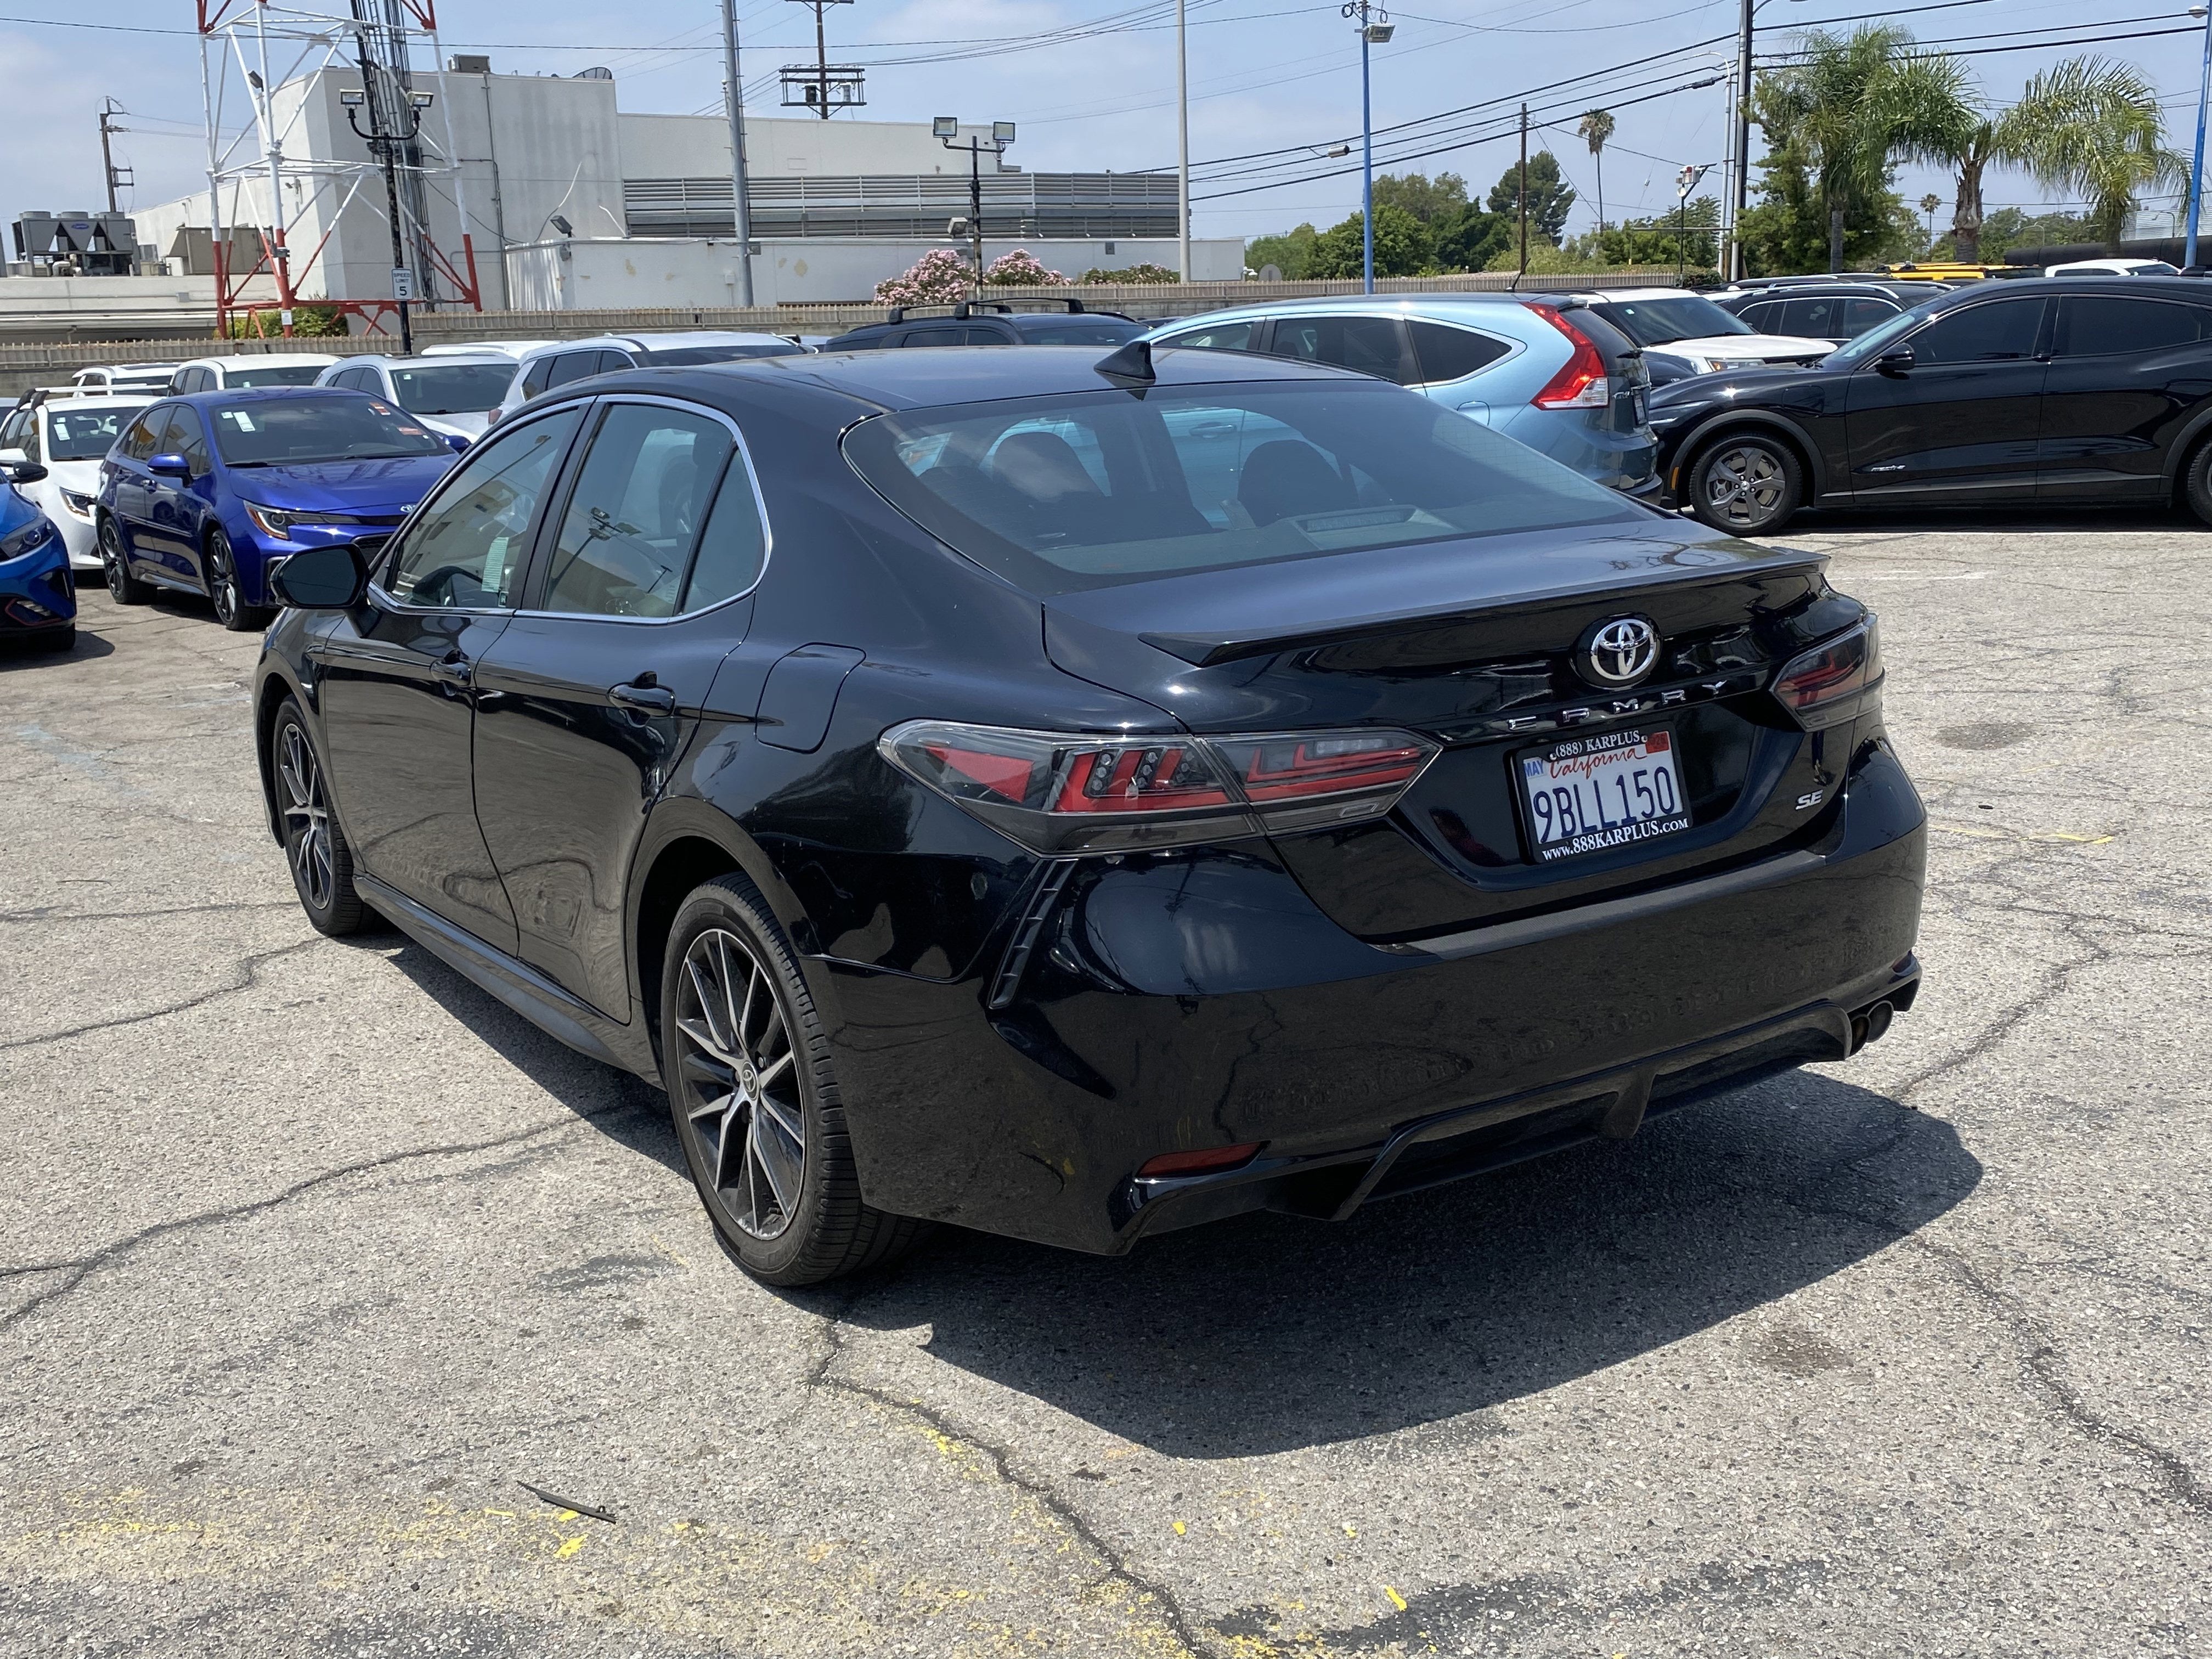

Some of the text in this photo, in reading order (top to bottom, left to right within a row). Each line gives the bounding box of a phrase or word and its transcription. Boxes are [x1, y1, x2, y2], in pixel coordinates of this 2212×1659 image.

[399, 286, 407, 296] 5
[1508, 679, 1728, 732] CAMRY
[1555, 741, 1583, 758] (888)
[1585, 730, 1640, 752] KARPLUS
[1524, 759, 1544, 777] MAY
[1550, 747, 1647, 780] California
[1533, 766, 1675, 843] 9BLL150
[1795, 789, 1824, 810] SE
